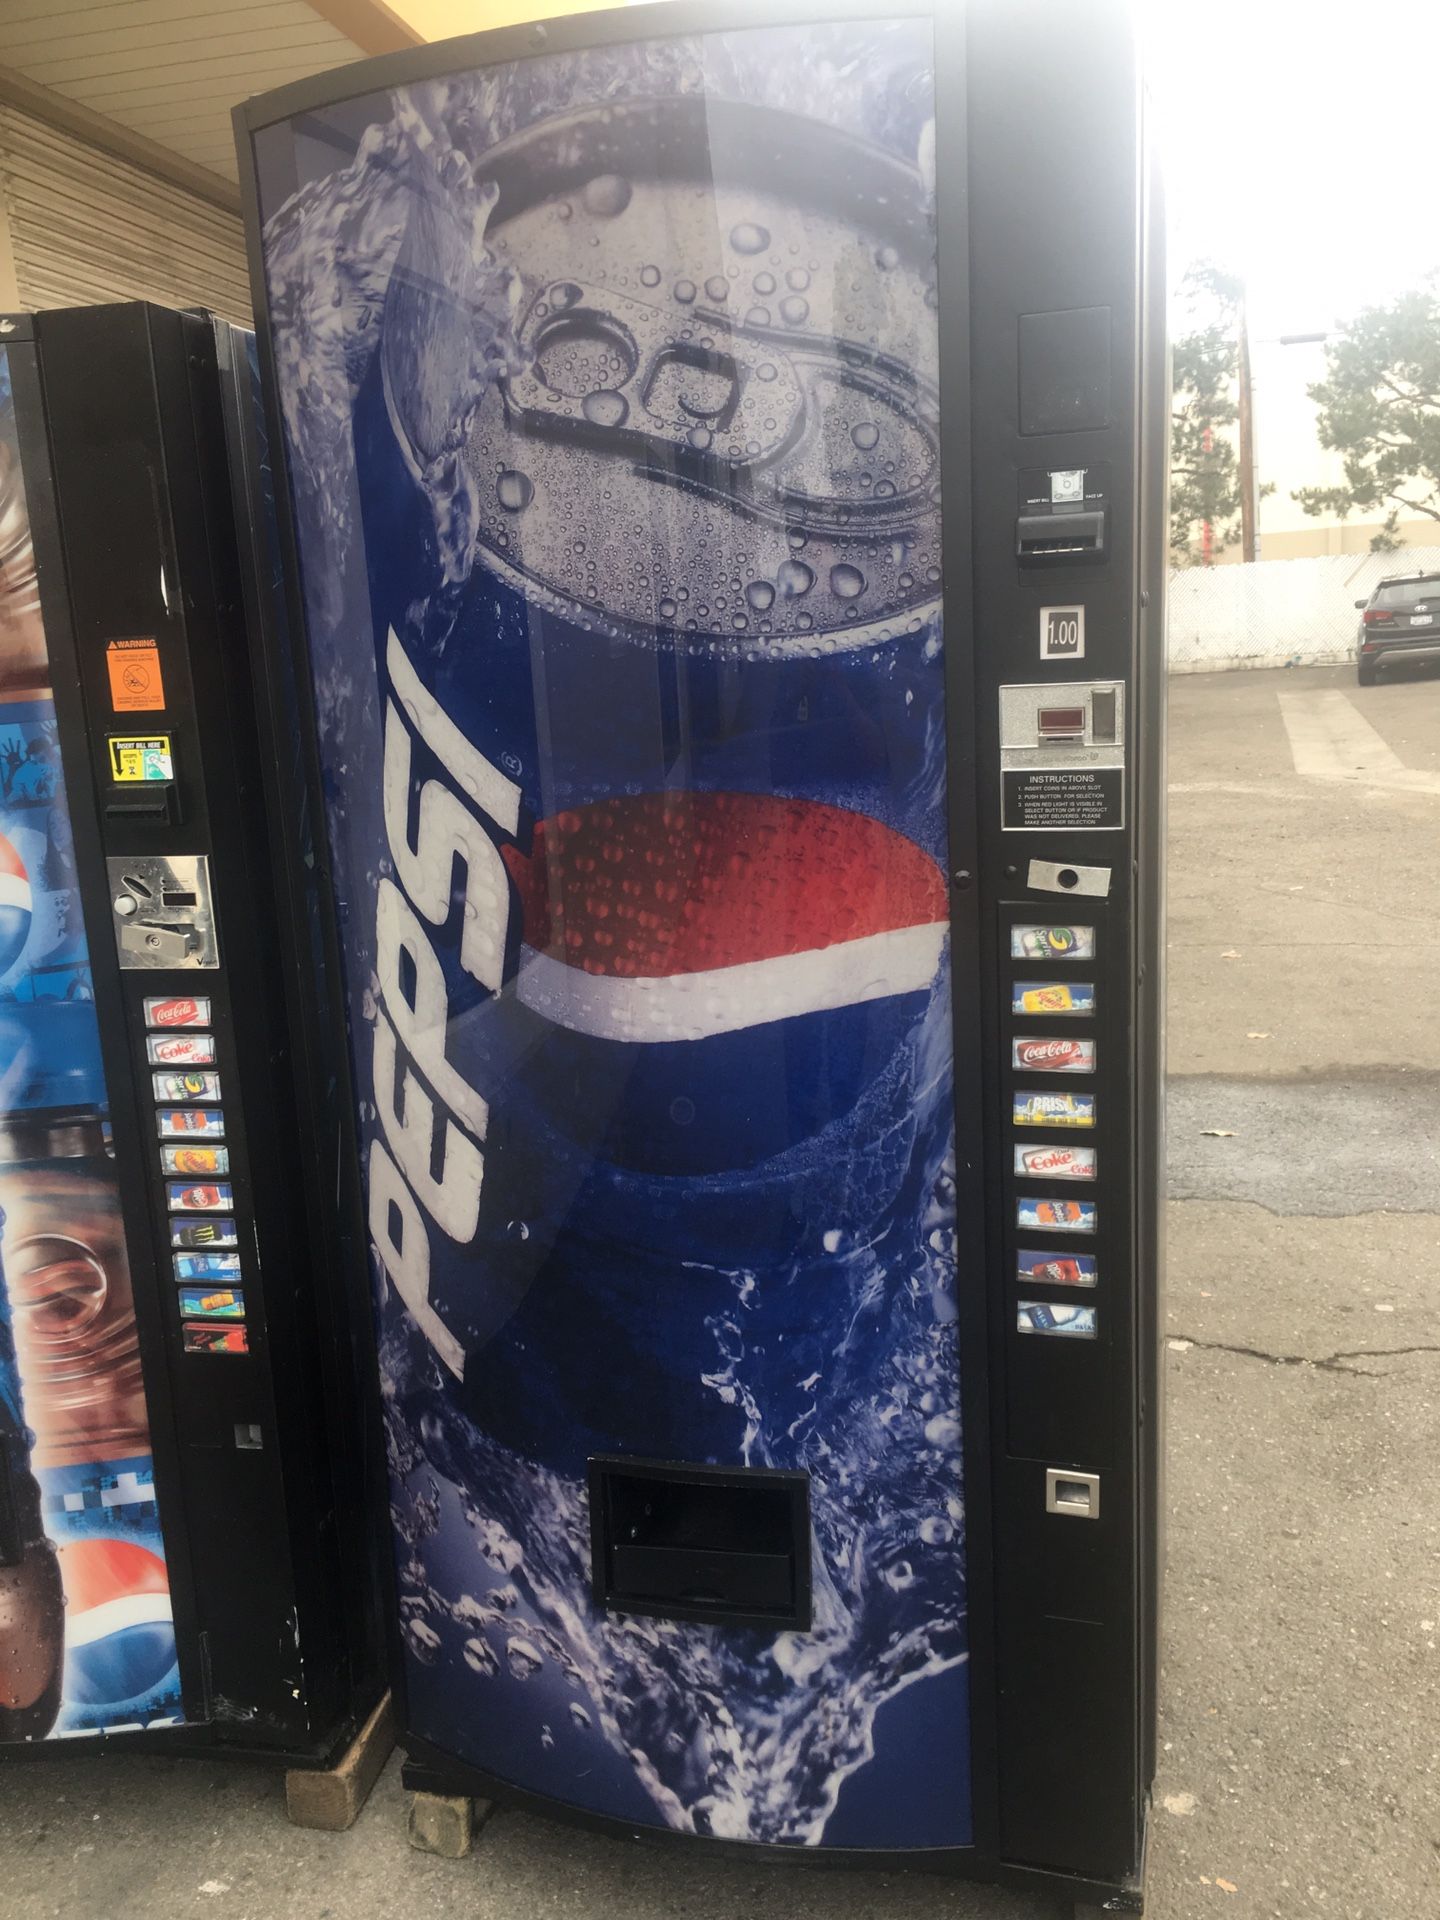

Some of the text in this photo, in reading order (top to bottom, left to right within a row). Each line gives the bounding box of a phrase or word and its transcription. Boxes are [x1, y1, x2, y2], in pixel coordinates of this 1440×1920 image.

[1048, 620, 1077, 645] 1.00
[116, 639, 157, 649] WARNING
[116, 741, 135, 749] INSERT
[147, 741, 161, 749] HERE
[1029, 774, 1095, 784] INSTRUCTIONS
[1034, 929, 1053, 958] Sprite
[369, 623, 523, 1383] PEPSI
[160, 1042, 193, 1060] Coke
[1030, 1152, 1073, 1170] Coke
